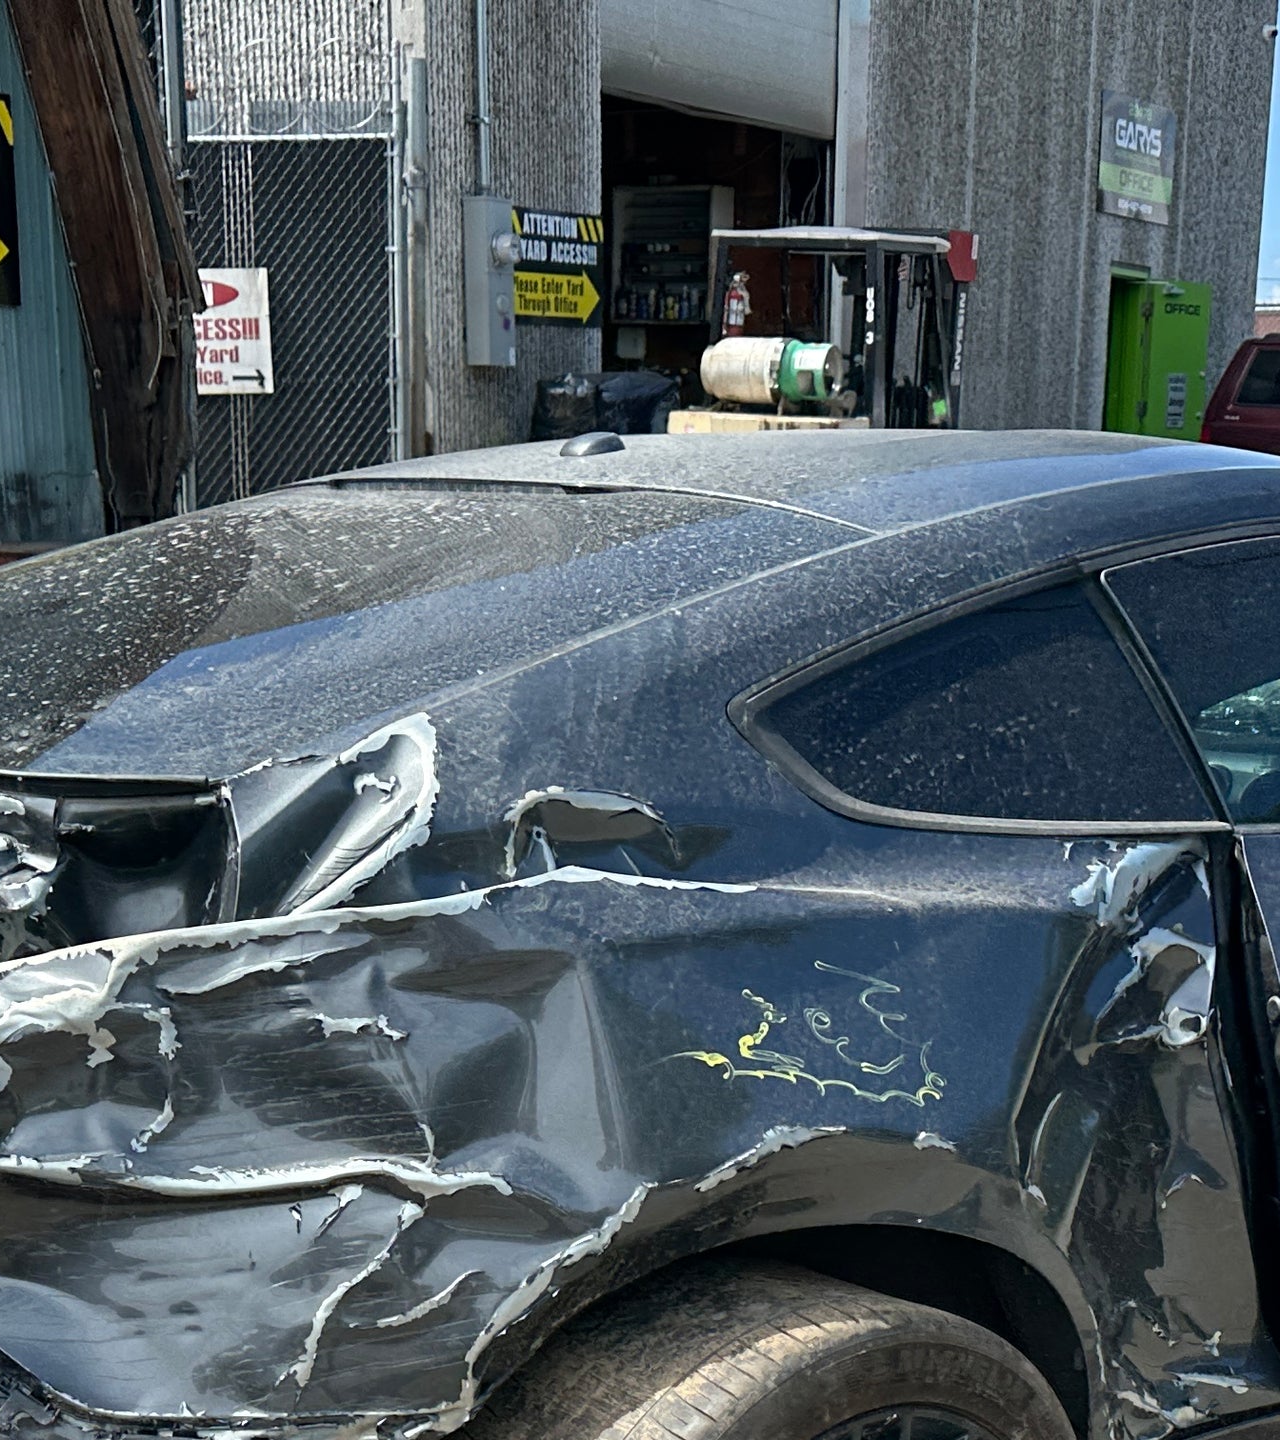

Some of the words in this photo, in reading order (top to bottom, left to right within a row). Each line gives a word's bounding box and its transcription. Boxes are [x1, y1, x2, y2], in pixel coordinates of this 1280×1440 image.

[1115, 118, 1162, 158] GARYS
[523, 212, 577, 239] ATTENTION
[520, 238, 548, 261] YARD
[541, 277, 563, 294] Enter
[567, 279, 584, 296] Yard
[518, 294, 551, 315] Through
[554, 295, 577, 313] Office
[1165, 303, 1201, 316] OFFICE
[954, 292, 967, 371] NISSAN
[197, 345, 239, 363] Yard
